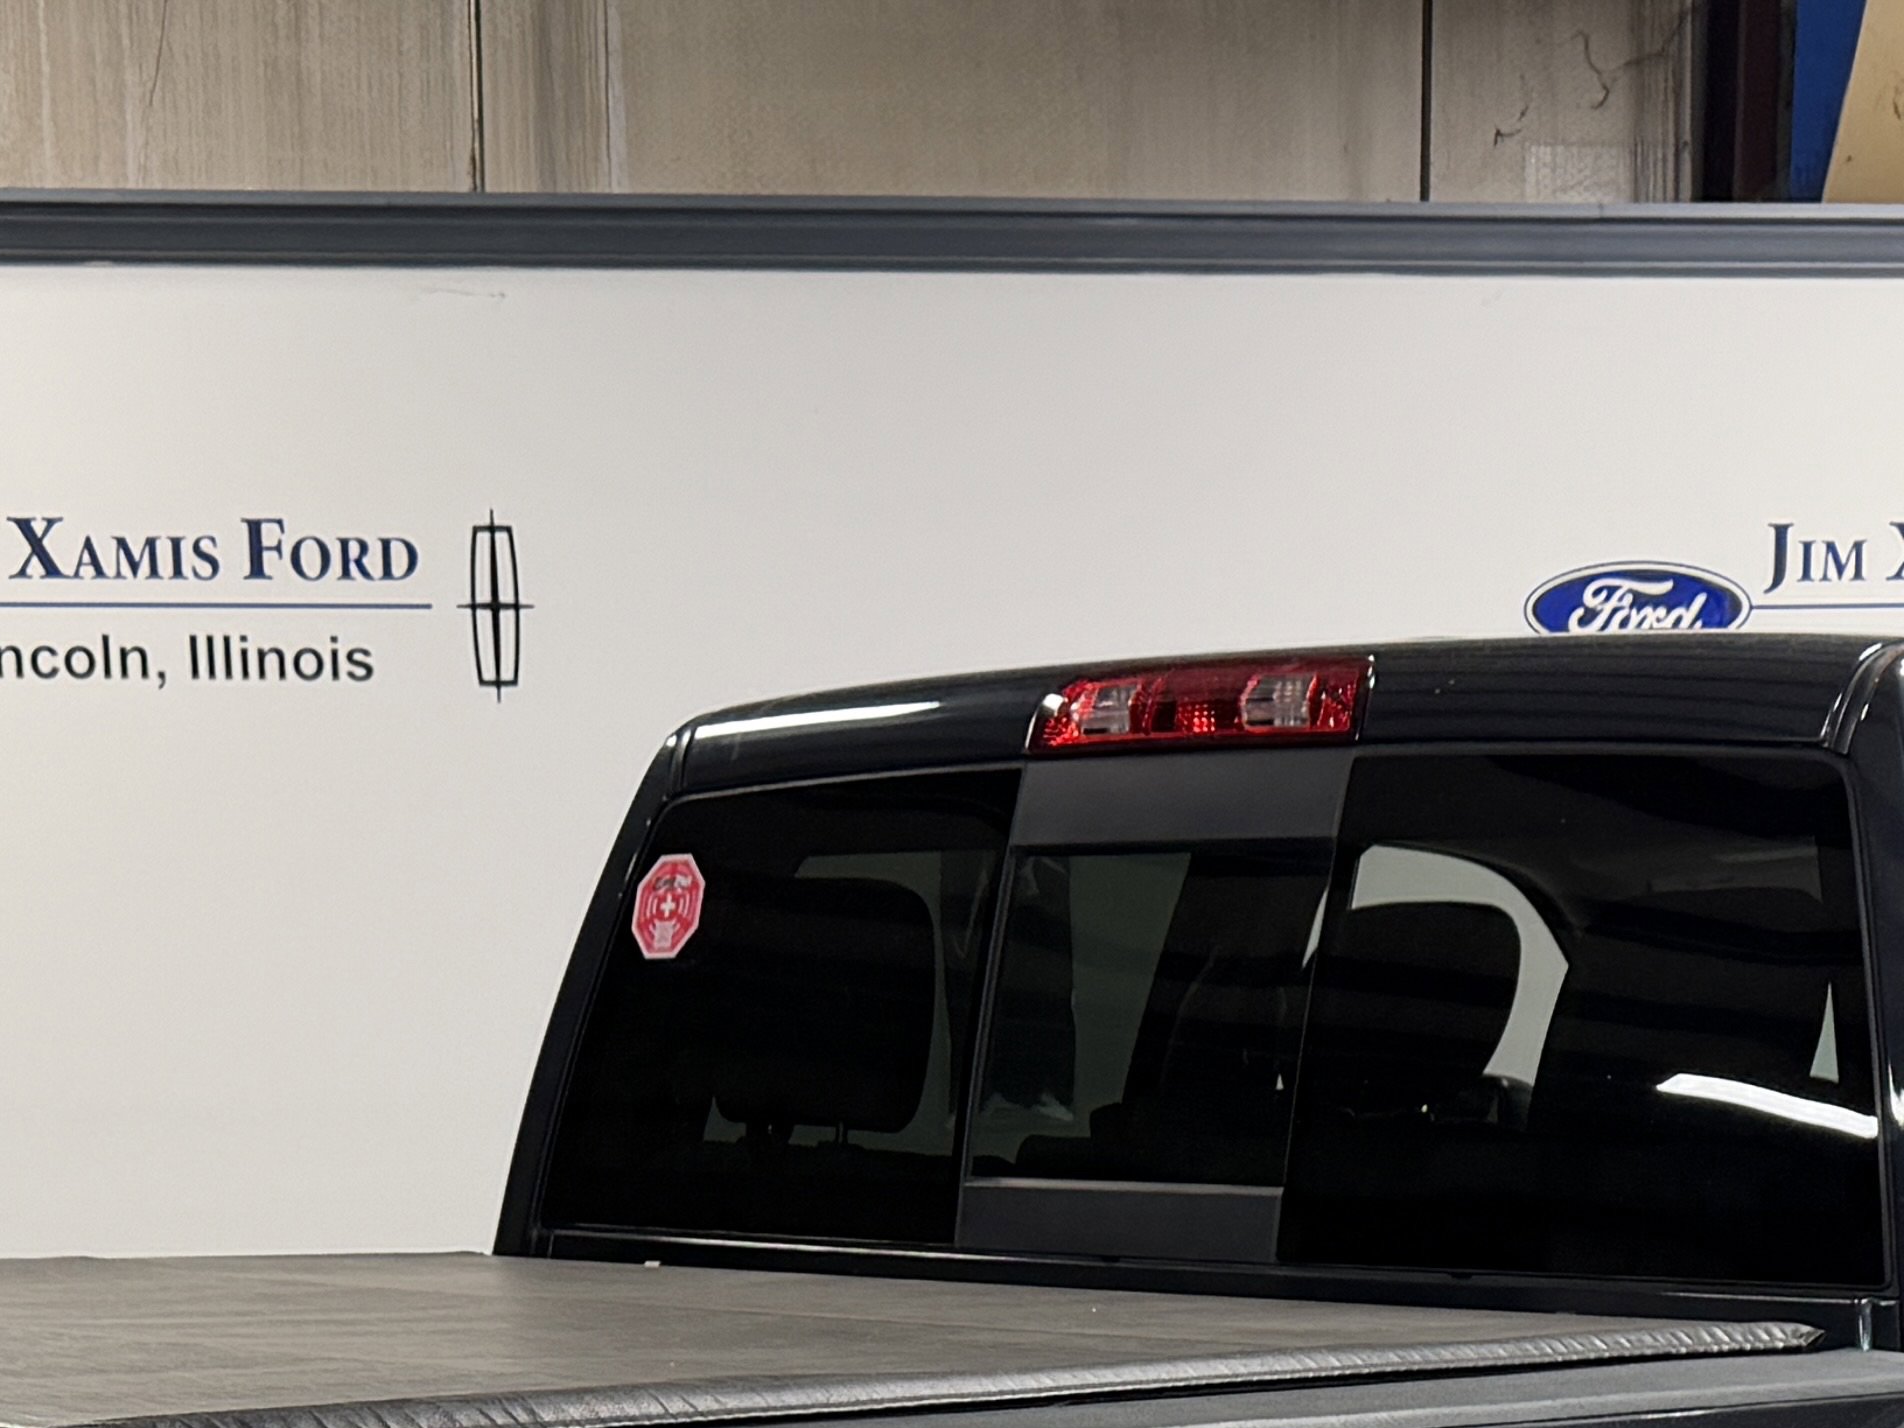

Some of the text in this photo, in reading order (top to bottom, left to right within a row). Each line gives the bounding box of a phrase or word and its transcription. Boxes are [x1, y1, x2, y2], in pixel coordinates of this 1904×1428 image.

[6, 516, 220, 582] XAMIS
[240, 517, 420, 582] FORD
[1765, 521, 1868, 594] JIM
[188, 634, 376, 683] Illinois
